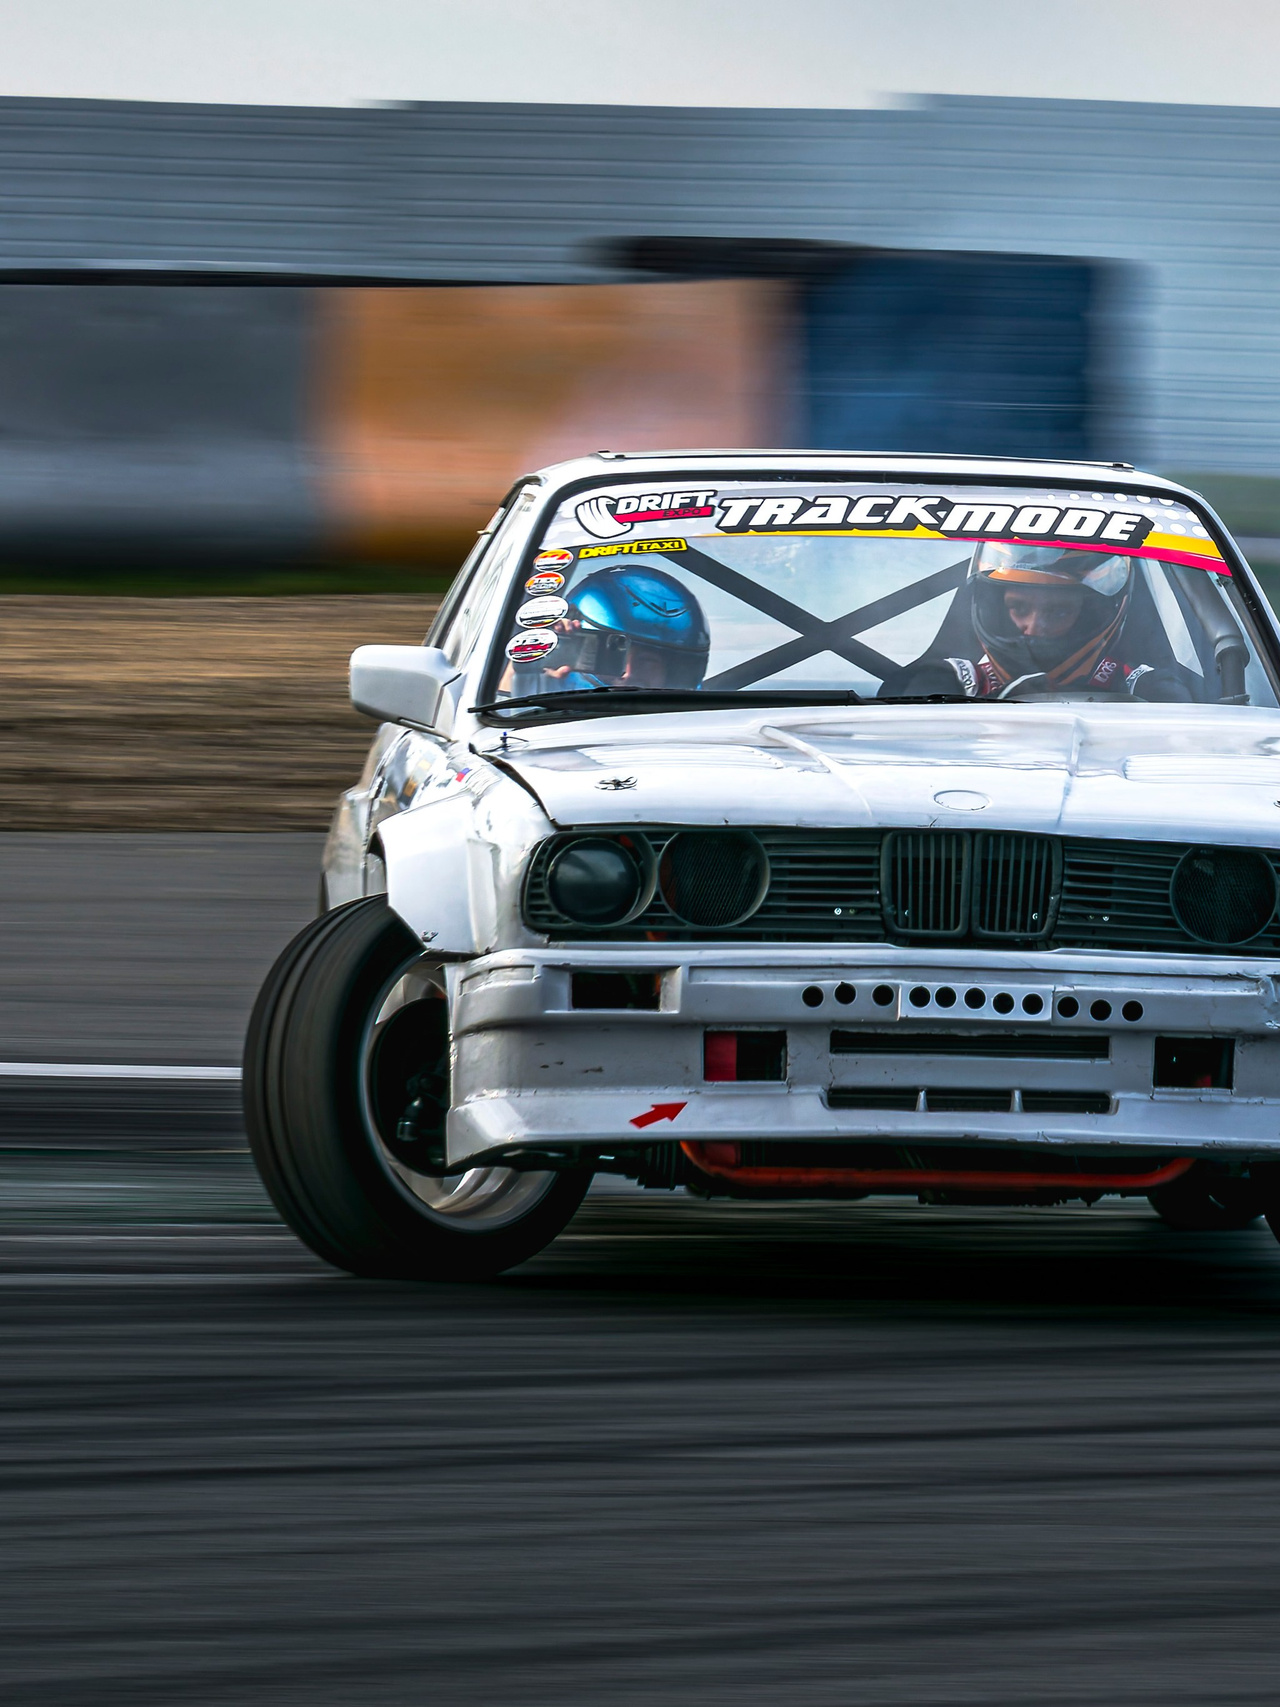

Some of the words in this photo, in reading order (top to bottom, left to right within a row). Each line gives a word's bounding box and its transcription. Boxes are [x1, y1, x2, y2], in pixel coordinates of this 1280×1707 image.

[616, 490, 715, 515] DRIFT
[662, 507, 701, 517] EXPO
[716, 496, 941, 528] TRACK
[939, 504, 1143, 541] MODE
[578, 542, 634, 559] DRIFT
[639, 540, 680, 551] TAXI
